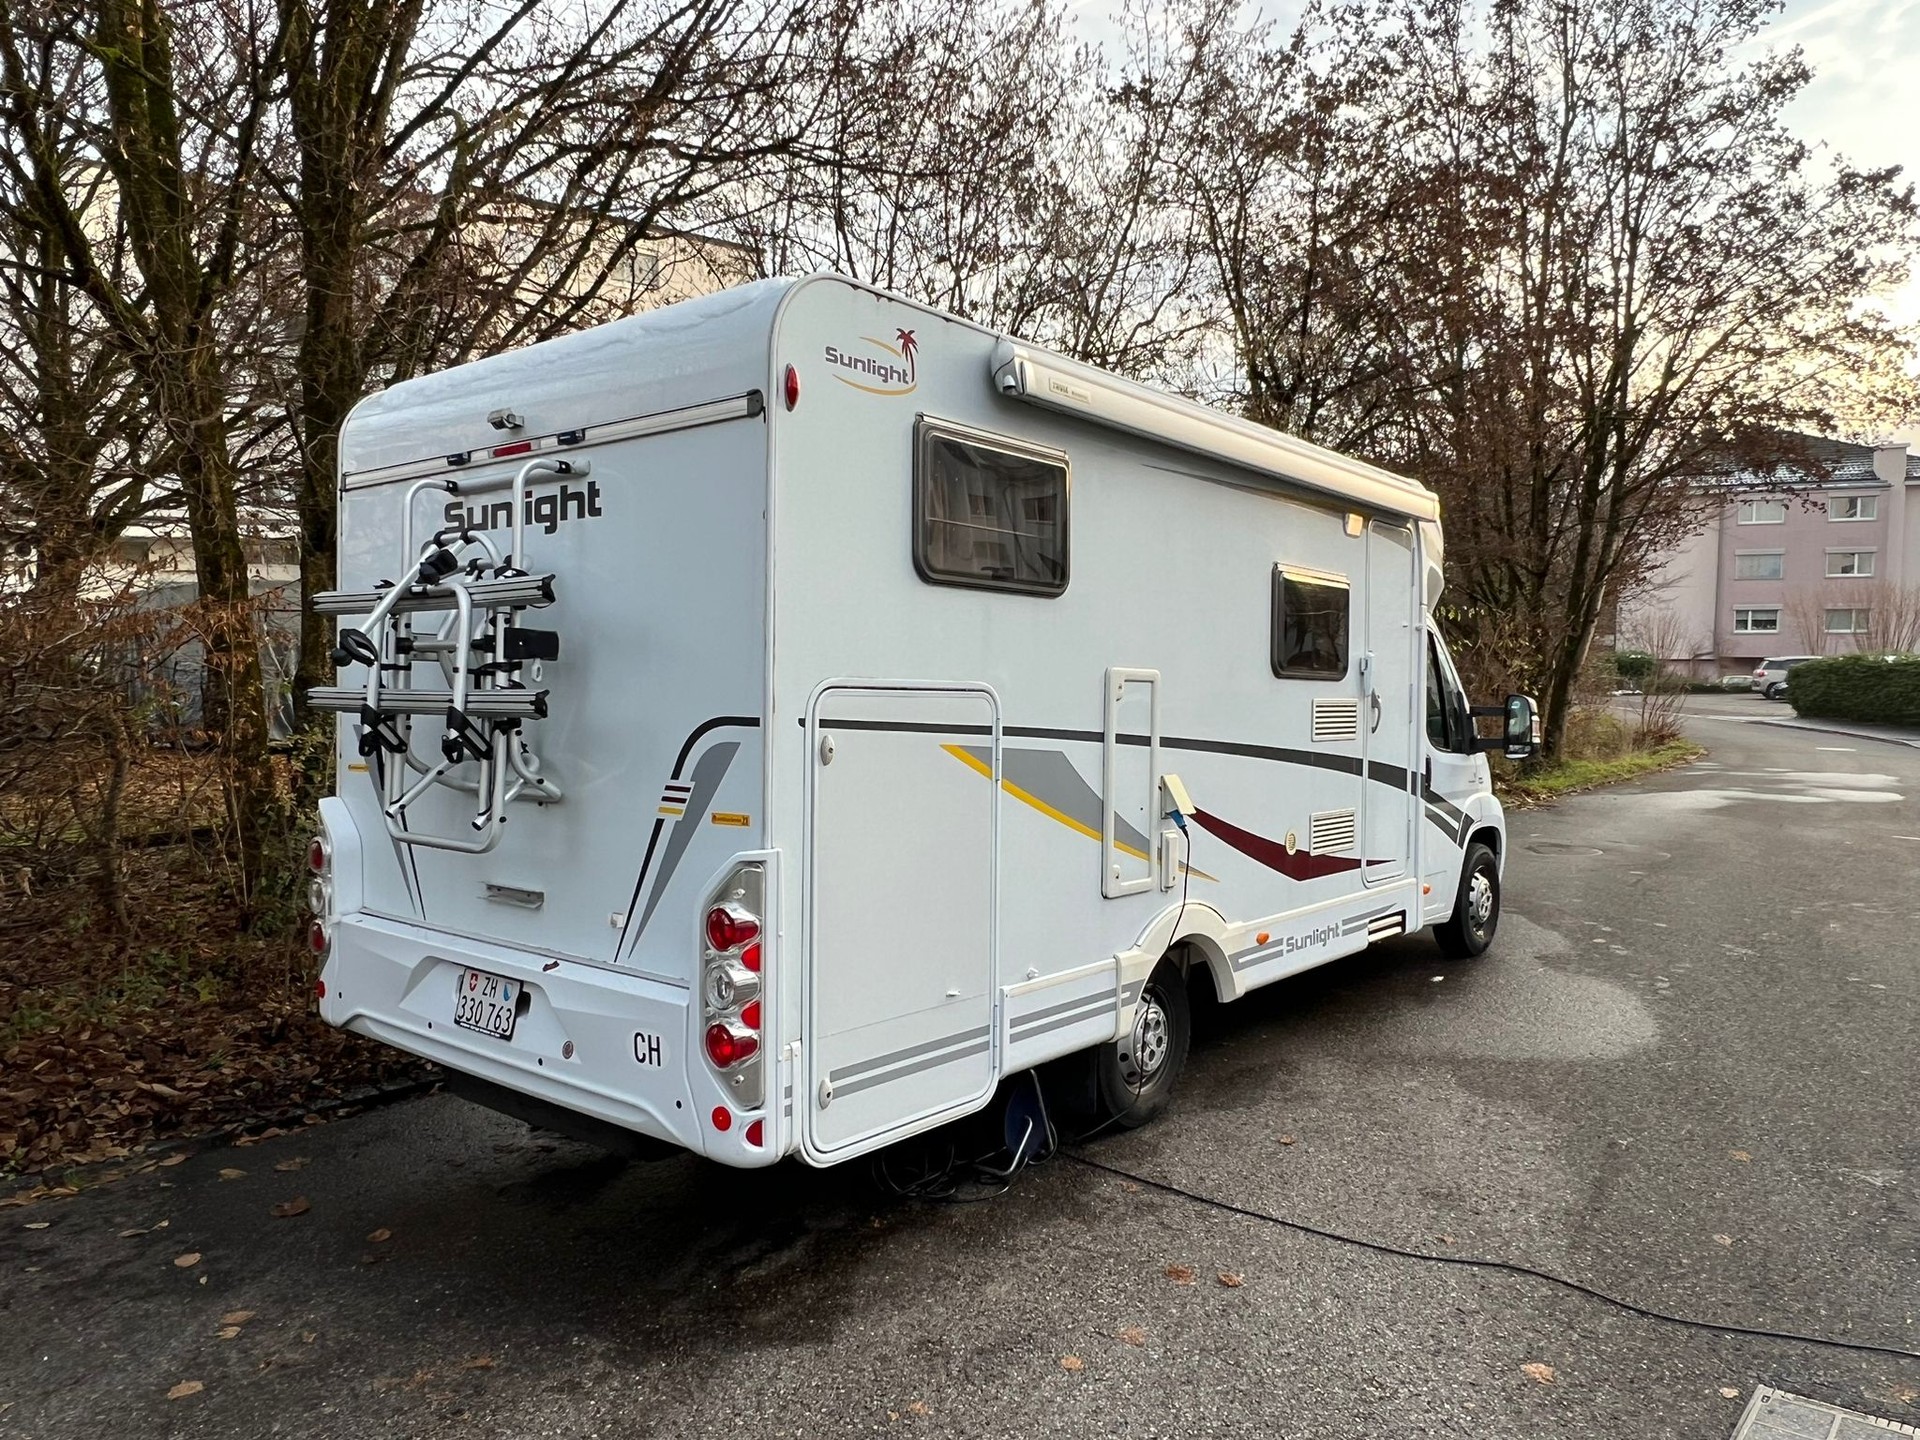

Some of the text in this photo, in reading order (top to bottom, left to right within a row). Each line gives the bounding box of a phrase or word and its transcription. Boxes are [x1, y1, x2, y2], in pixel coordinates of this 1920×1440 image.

[825, 346, 909, 384] Sunlight
[444, 481, 602, 534] Sunight
[1286, 923, 1340, 954] Sunlight
[482, 976, 498, 998] ZH
[457, 995, 483, 1025] 330
[486, 1003, 512, 1033] 763
[634, 1032, 661, 1066] CH
